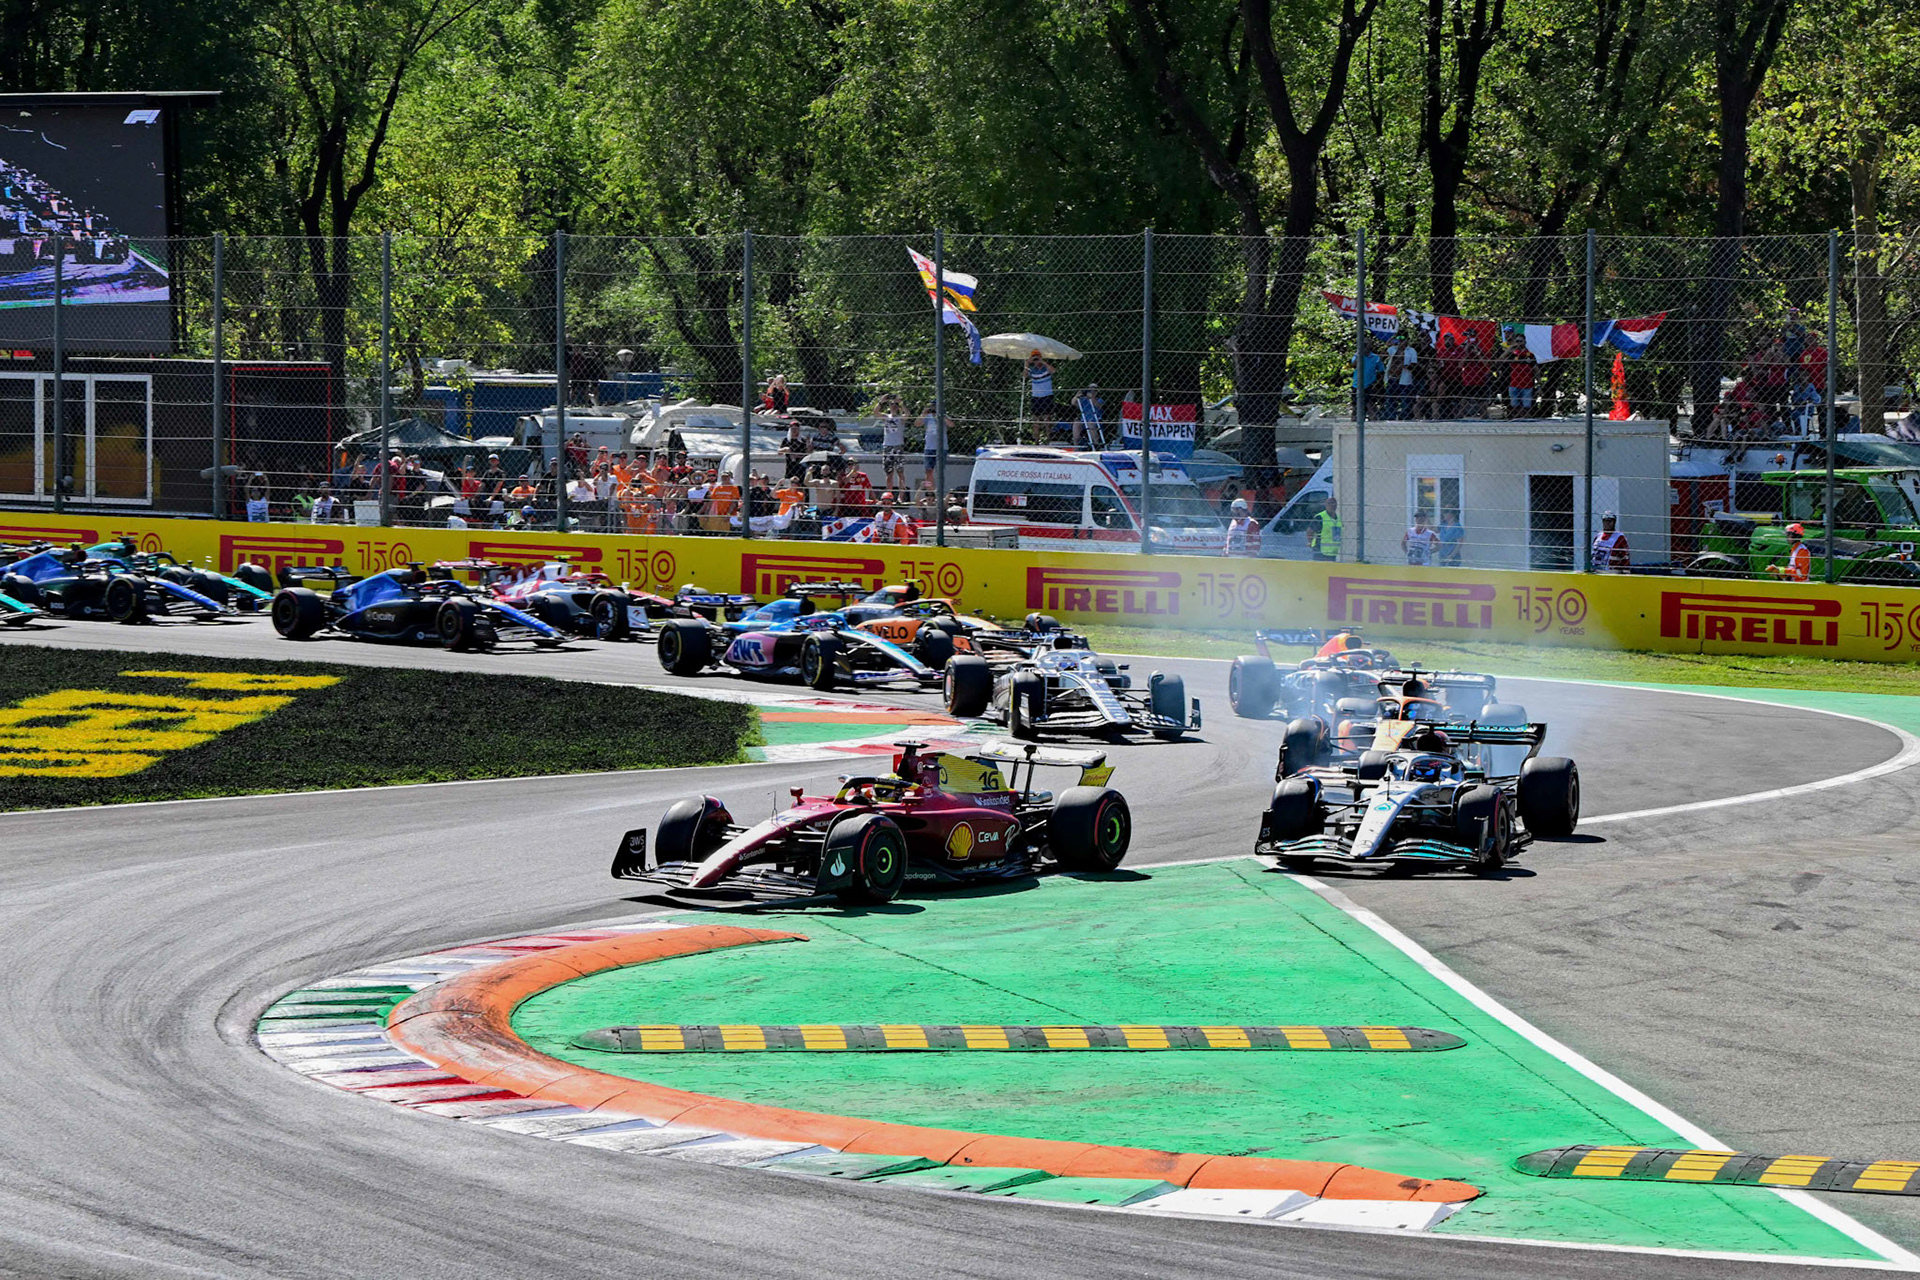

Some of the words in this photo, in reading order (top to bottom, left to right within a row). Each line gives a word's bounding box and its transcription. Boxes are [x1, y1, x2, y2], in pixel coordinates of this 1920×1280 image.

[1341, 298, 1379, 312] MX
[1364, 316, 1397, 330] PPEN
[1043, 472, 1072, 480] ITALIANA
[741, 553, 885, 599] PIRELI
[1027, 567, 1182, 615] PIRELLI
[1328, 577, 1496, 629] PIRELLI
[1513, 586, 1587, 633] 150
[1660, 591, 1842, 646] PIRELLI
[1558, 626, 1585, 636] YEARS
[732, 639, 766, 662] BWT
[979, 771, 998, 791] 16
